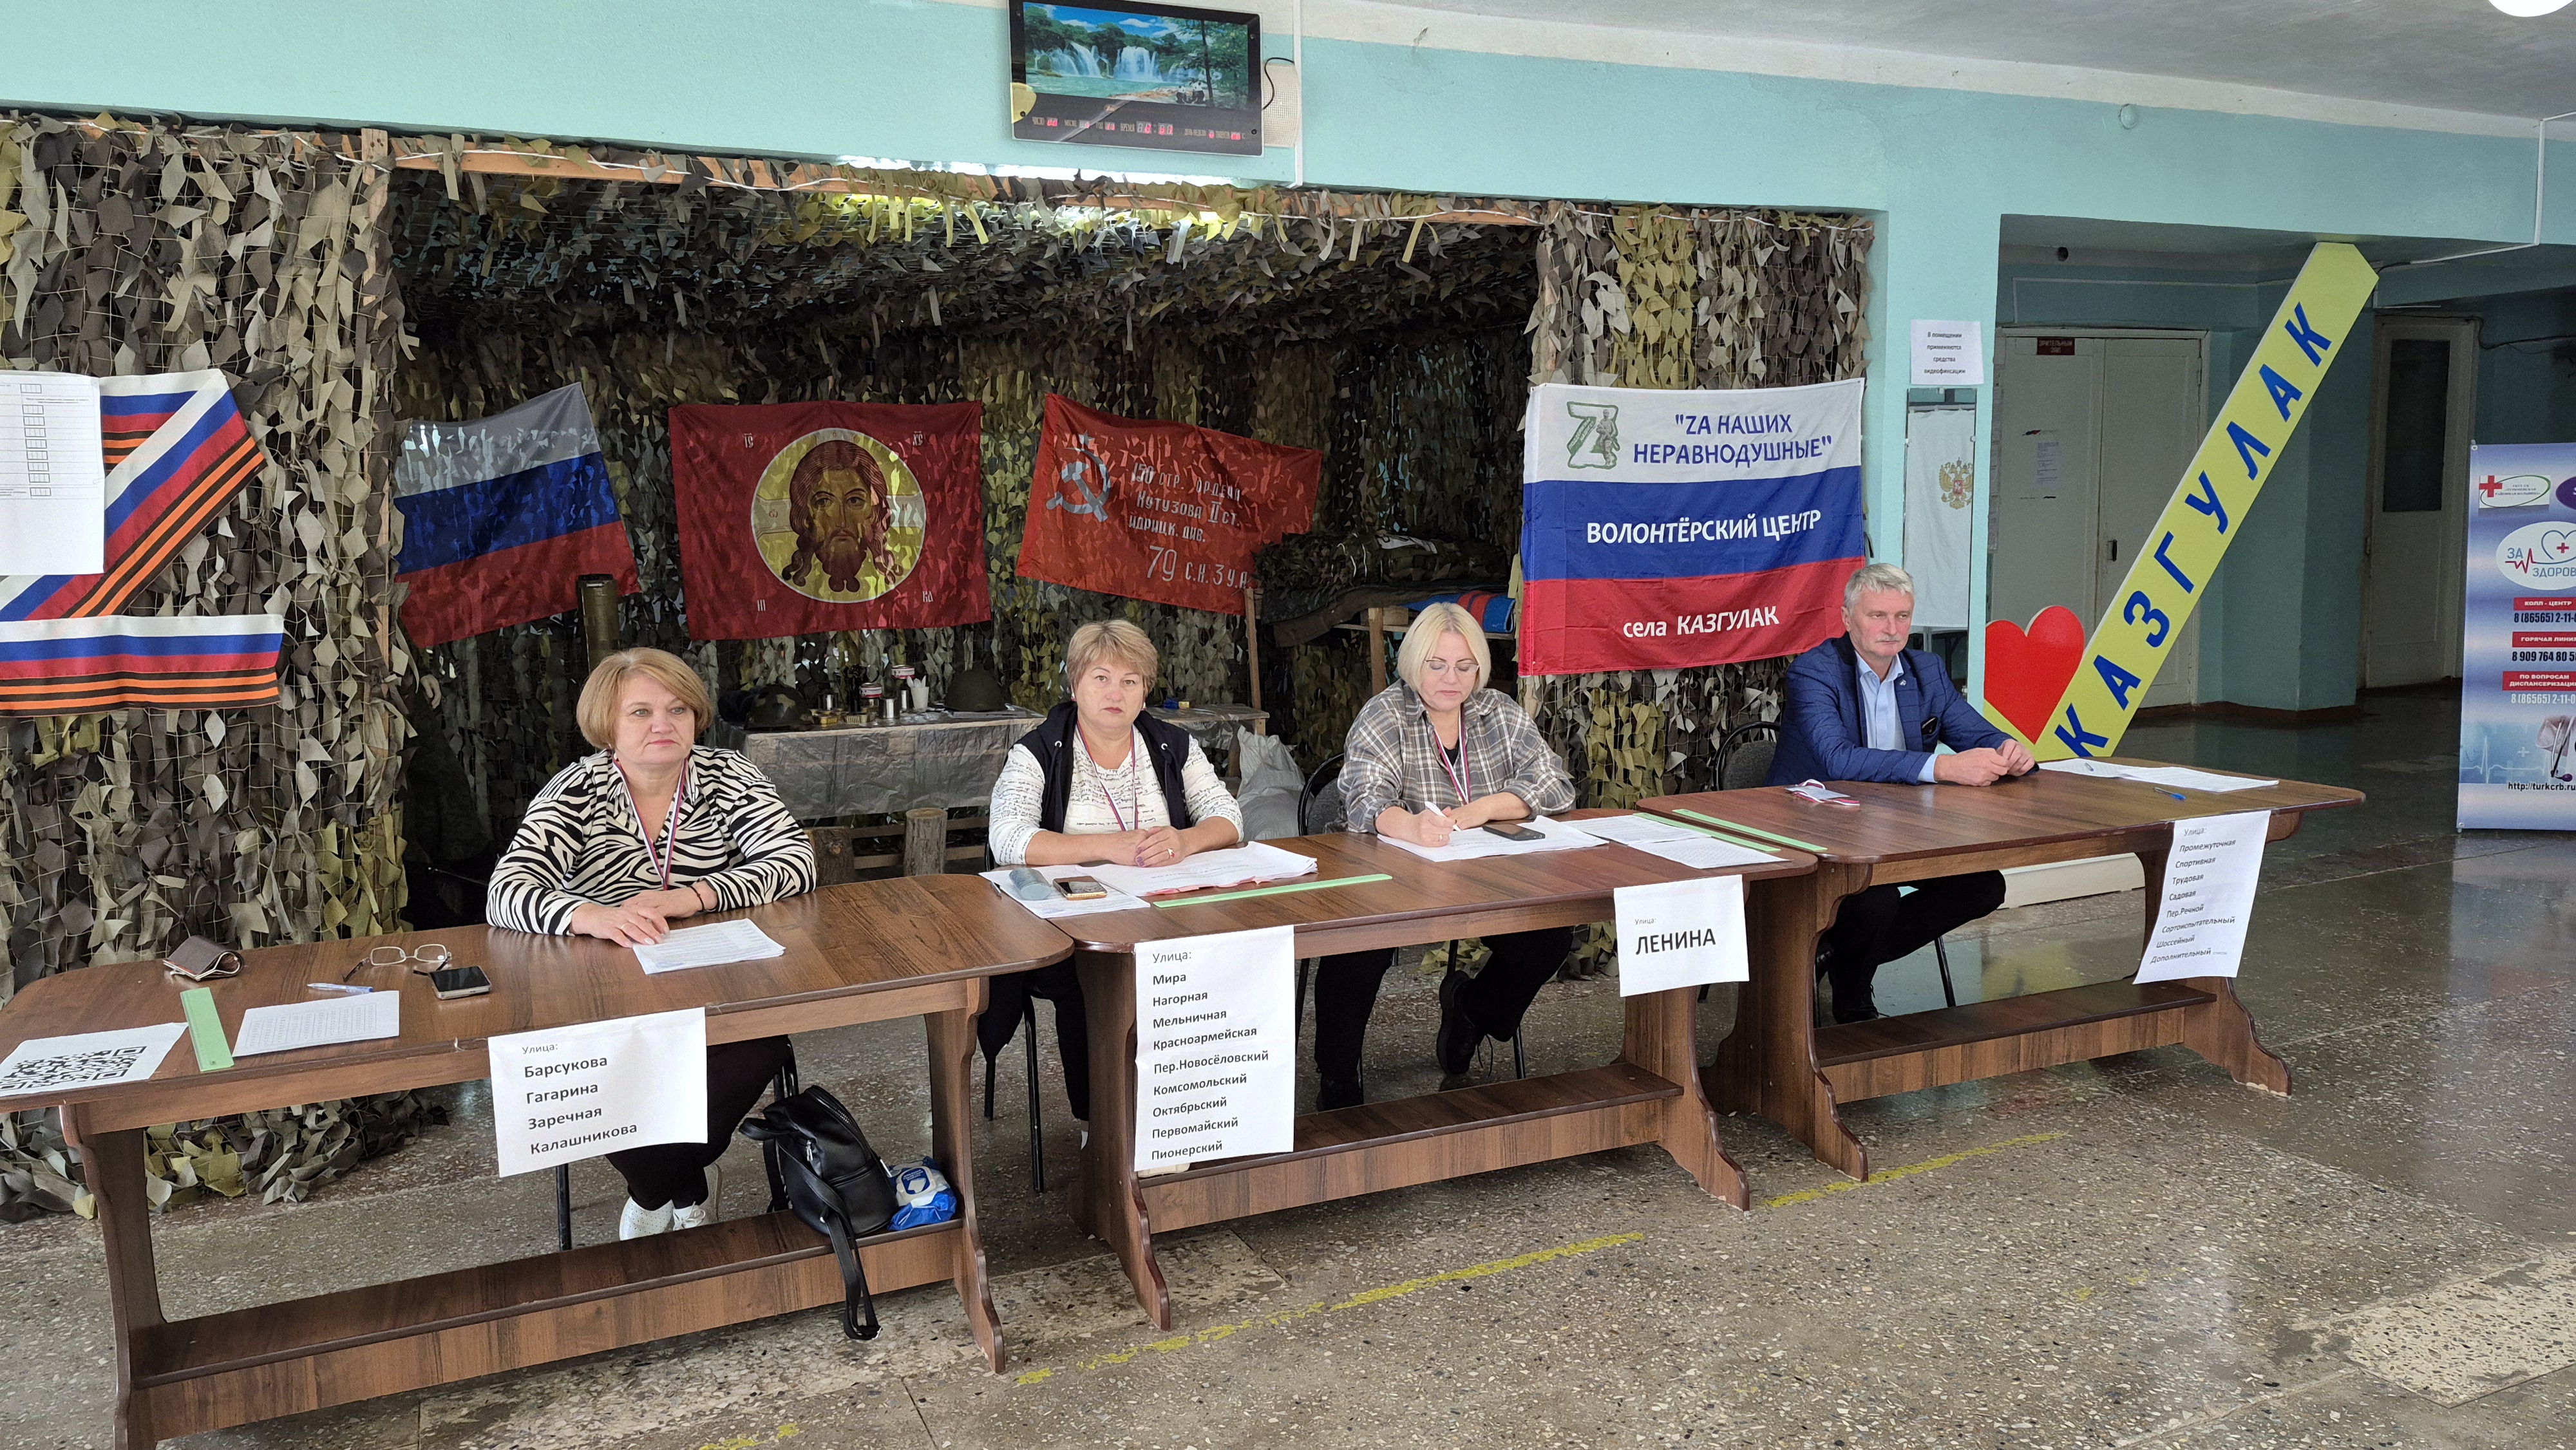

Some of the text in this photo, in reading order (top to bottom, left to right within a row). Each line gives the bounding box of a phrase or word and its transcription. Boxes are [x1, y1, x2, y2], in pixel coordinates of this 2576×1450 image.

[1718, 414, 1793, 435] НАШИХ
[1633, 435, 1832, 468] НЕРАВНОДУШНЫЕ"
[1132, 462, 1155, 484] 150
[1159, 472, 1185, 490] СТР.
[1129, 515, 1206, 542] ИДРИЦК. ДИВ.
[1587, 509, 1822, 544] ВОЛОНТЁРСКИЙ ЦЕНТР
[2054, 301, 2332, 757] КАЗГУЛАК
[2507, 547, 2523, 559] ЗА
[1147, 545, 1177, 581] 79
[1623, 606, 1780, 639] села КАЗГУЛАК
[2514, 613, 2519, 623] 8
[2521, 612, 2554, 623] (86565)
[2512, 651, 2576, 662] 8 909 764 80 5
[2511, 693, 2517, 704] 8
[2518, 693, 2551, 704] (86565)
[2508, 782, 2576, 792] http://turkcrb.ru
[2184, 827, 2207, 836] Улица:
[2179, 839, 2236, 852] Промежуточная
[2175, 857, 2216, 868] Спортивная
[2172, 874, 2204, 885] Трудовая
[2169, 890, 2196, 901] Садовая
[2166, 904, 2204, 918] Пер.Речной
[2161, 916, 2235, 934] Сортоиспытательный
[1636, 928, 1716, 955] ЛЕНИНА
[2156, 935, 2195, 948] Шоссейный
[1152, 951, 1192, 963] Улица:
[2150, 948, 2211, 965] Дополнительный
[1153, 974, 1186, 986] Мира
[1153, 992, 1208, 1006] Нагорная
[1153, 1010, 1227, 1029] Мельничная
[522, 1043, 558, 1055] Улица:
[1153, 1028, 1257, 1051] Красноармейская
[524, 1057, 607, 1078] Барсукова
[1154, 1050, 1269, 1075] Пер.Новосёловский
[526, 1084, 598, 1104] Гагарина
[1153, 1074, 1247, 1096] Комсомольский
[1153, 1097, 1227, 1118] Октябрьский
[527, 1107, 602, 1130] Заречная
[1151, 1117, 1238, 1139] Первомайский
[530, 1124, 638, 1155] Калашникова
[1151, 1140, 1223, 1161] Пионерский
